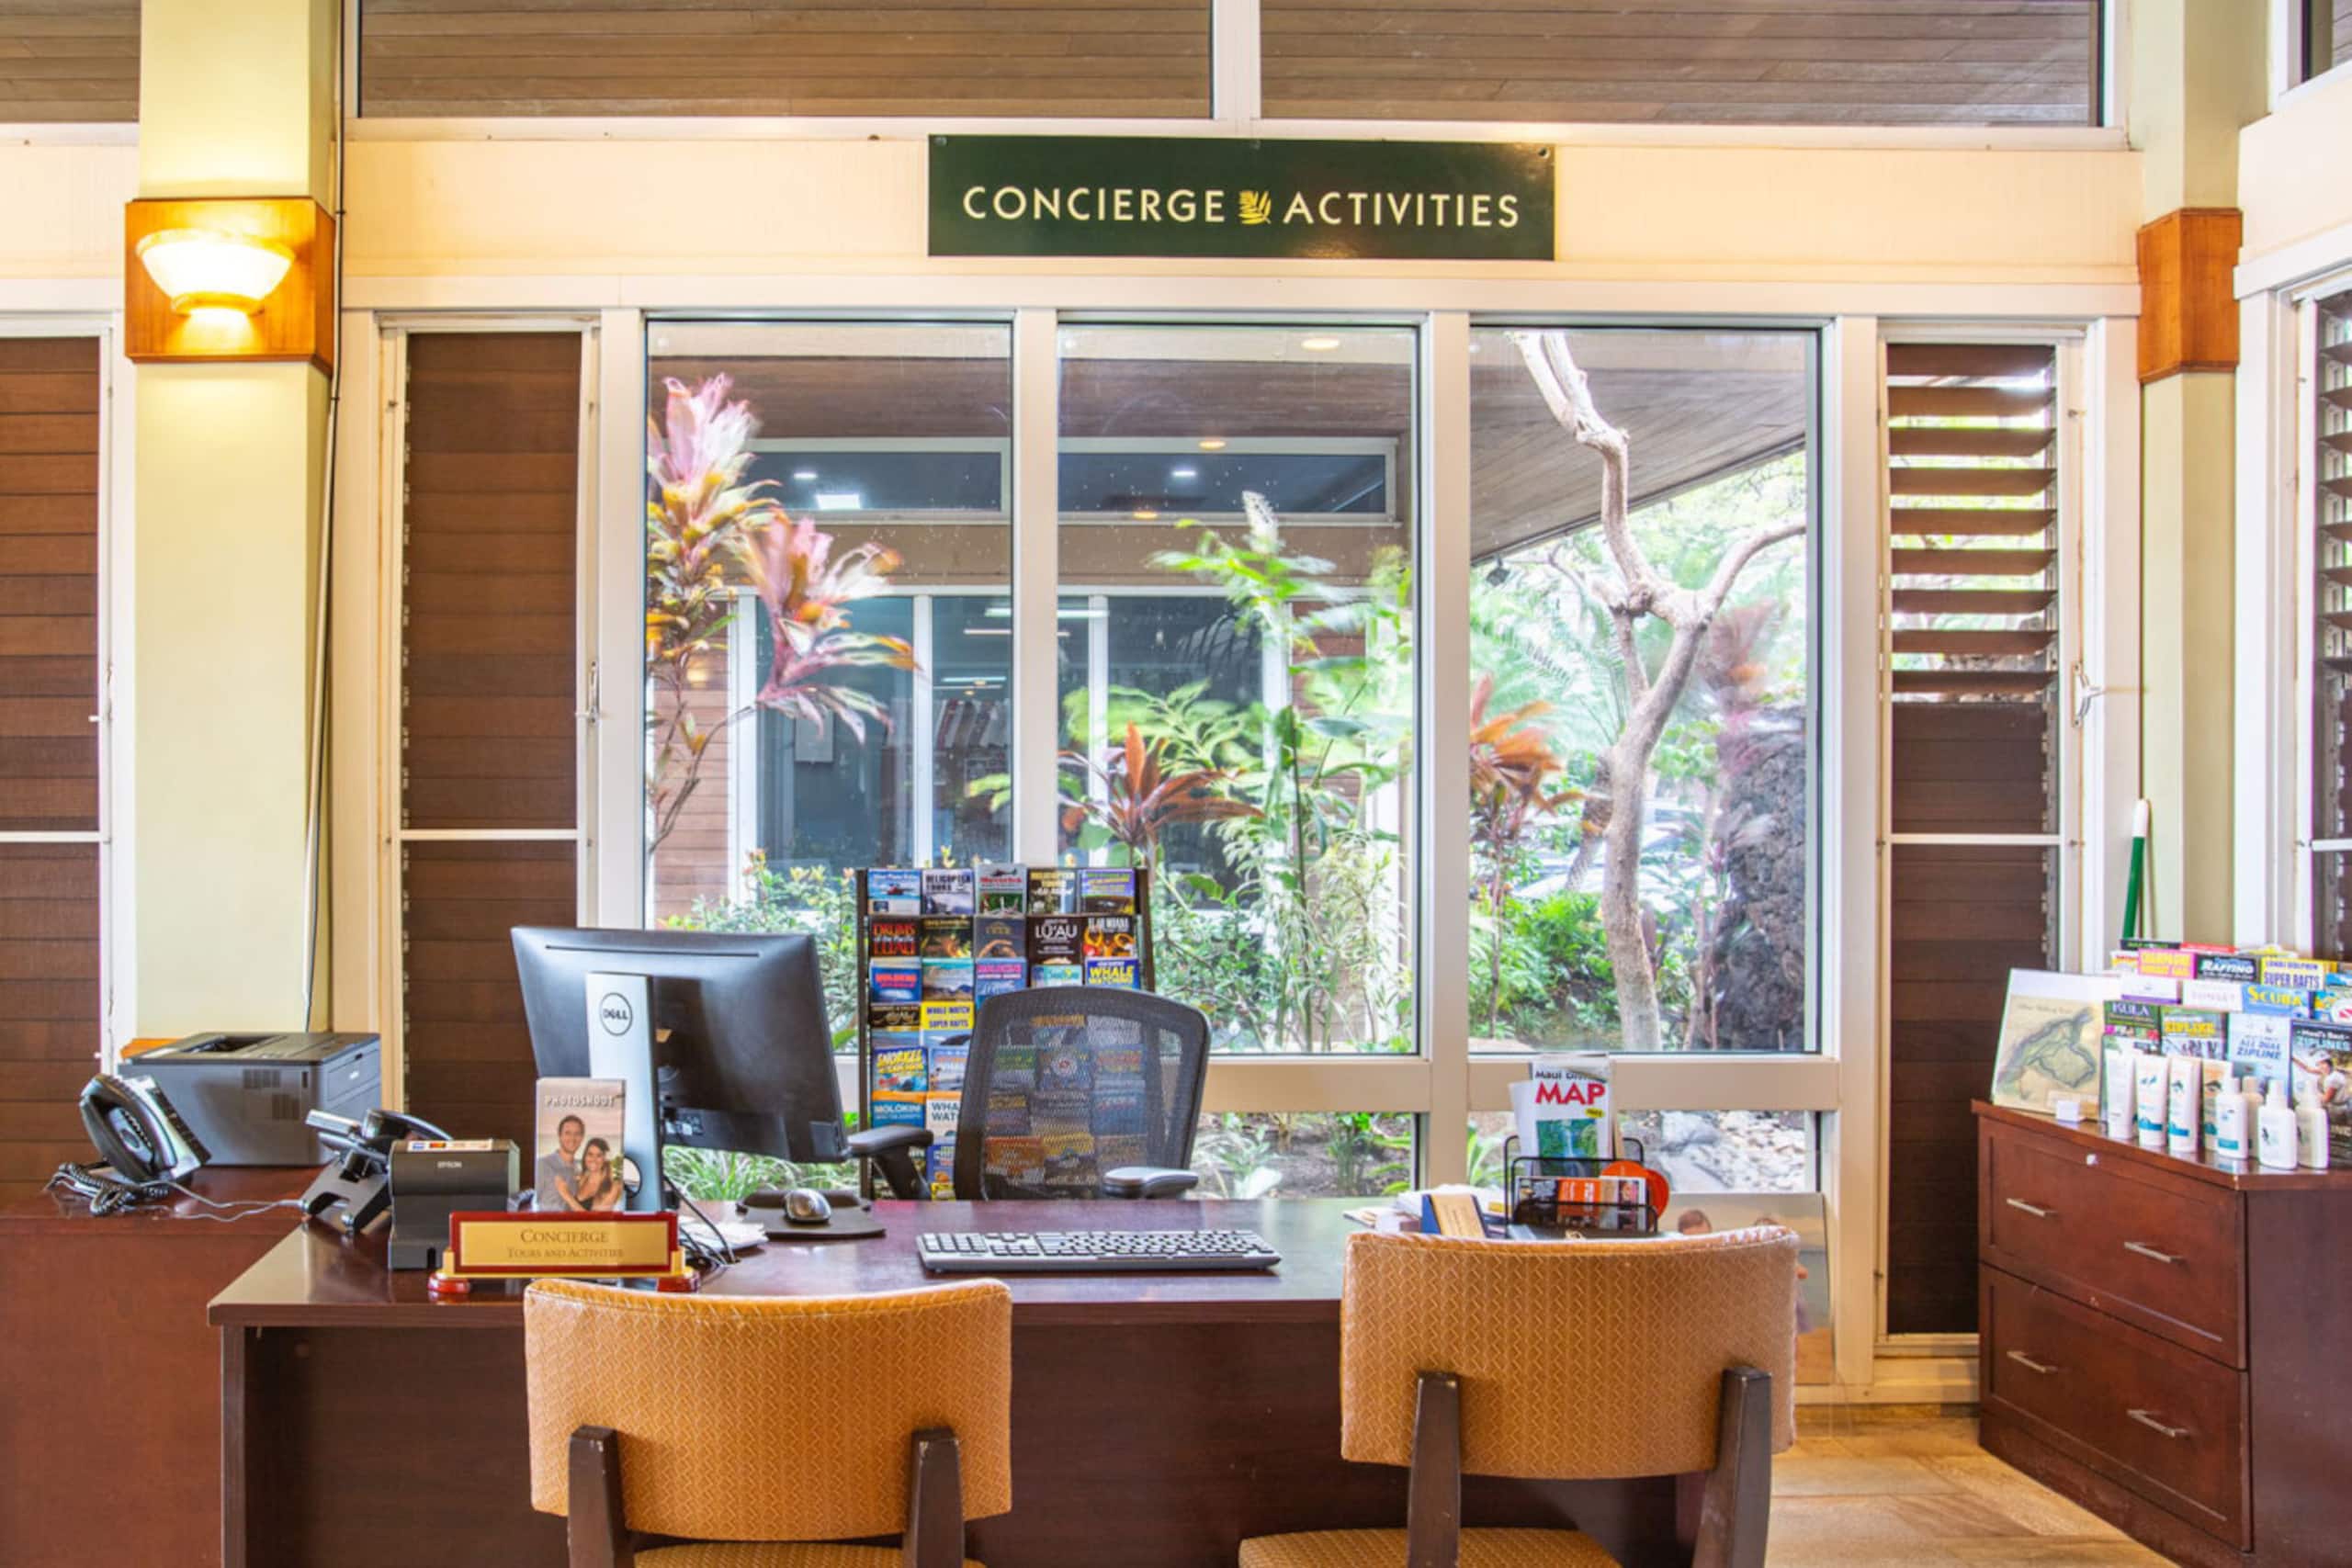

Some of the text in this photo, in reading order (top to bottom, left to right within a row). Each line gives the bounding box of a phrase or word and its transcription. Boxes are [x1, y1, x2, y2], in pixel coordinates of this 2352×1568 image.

[963, 186, 1519, 228] CONCIERGE ACTIVITIES
[1089, 965, 1135, 978] WHALE
[2247, 985, 2302, 1007] SCUBA
[602, 1008, 628, 1020] DELL
[1534, 1081, 1606, 1105] MAP
[932, 1102, 959, 1111] WHA
[932, 1112, 956, 1121] WAT
[520, 1229, 610, 1243] CONCIERGE
